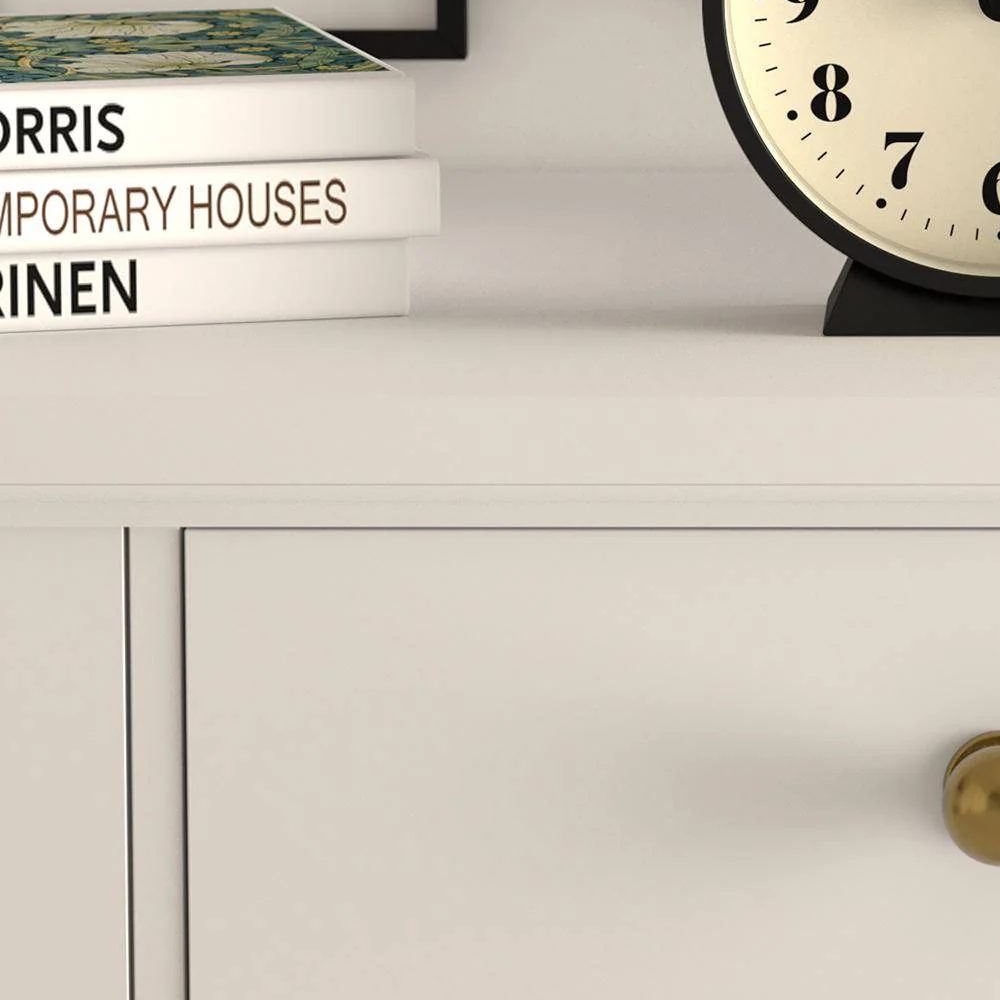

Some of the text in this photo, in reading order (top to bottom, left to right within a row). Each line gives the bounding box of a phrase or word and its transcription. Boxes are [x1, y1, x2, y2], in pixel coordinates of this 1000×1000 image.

[810, 64, 852, 122] 8
[884, 132, 925, 190] 7
[189, 178, 348, 230] HOUSES
[0, 259, 138, 318] INEN
